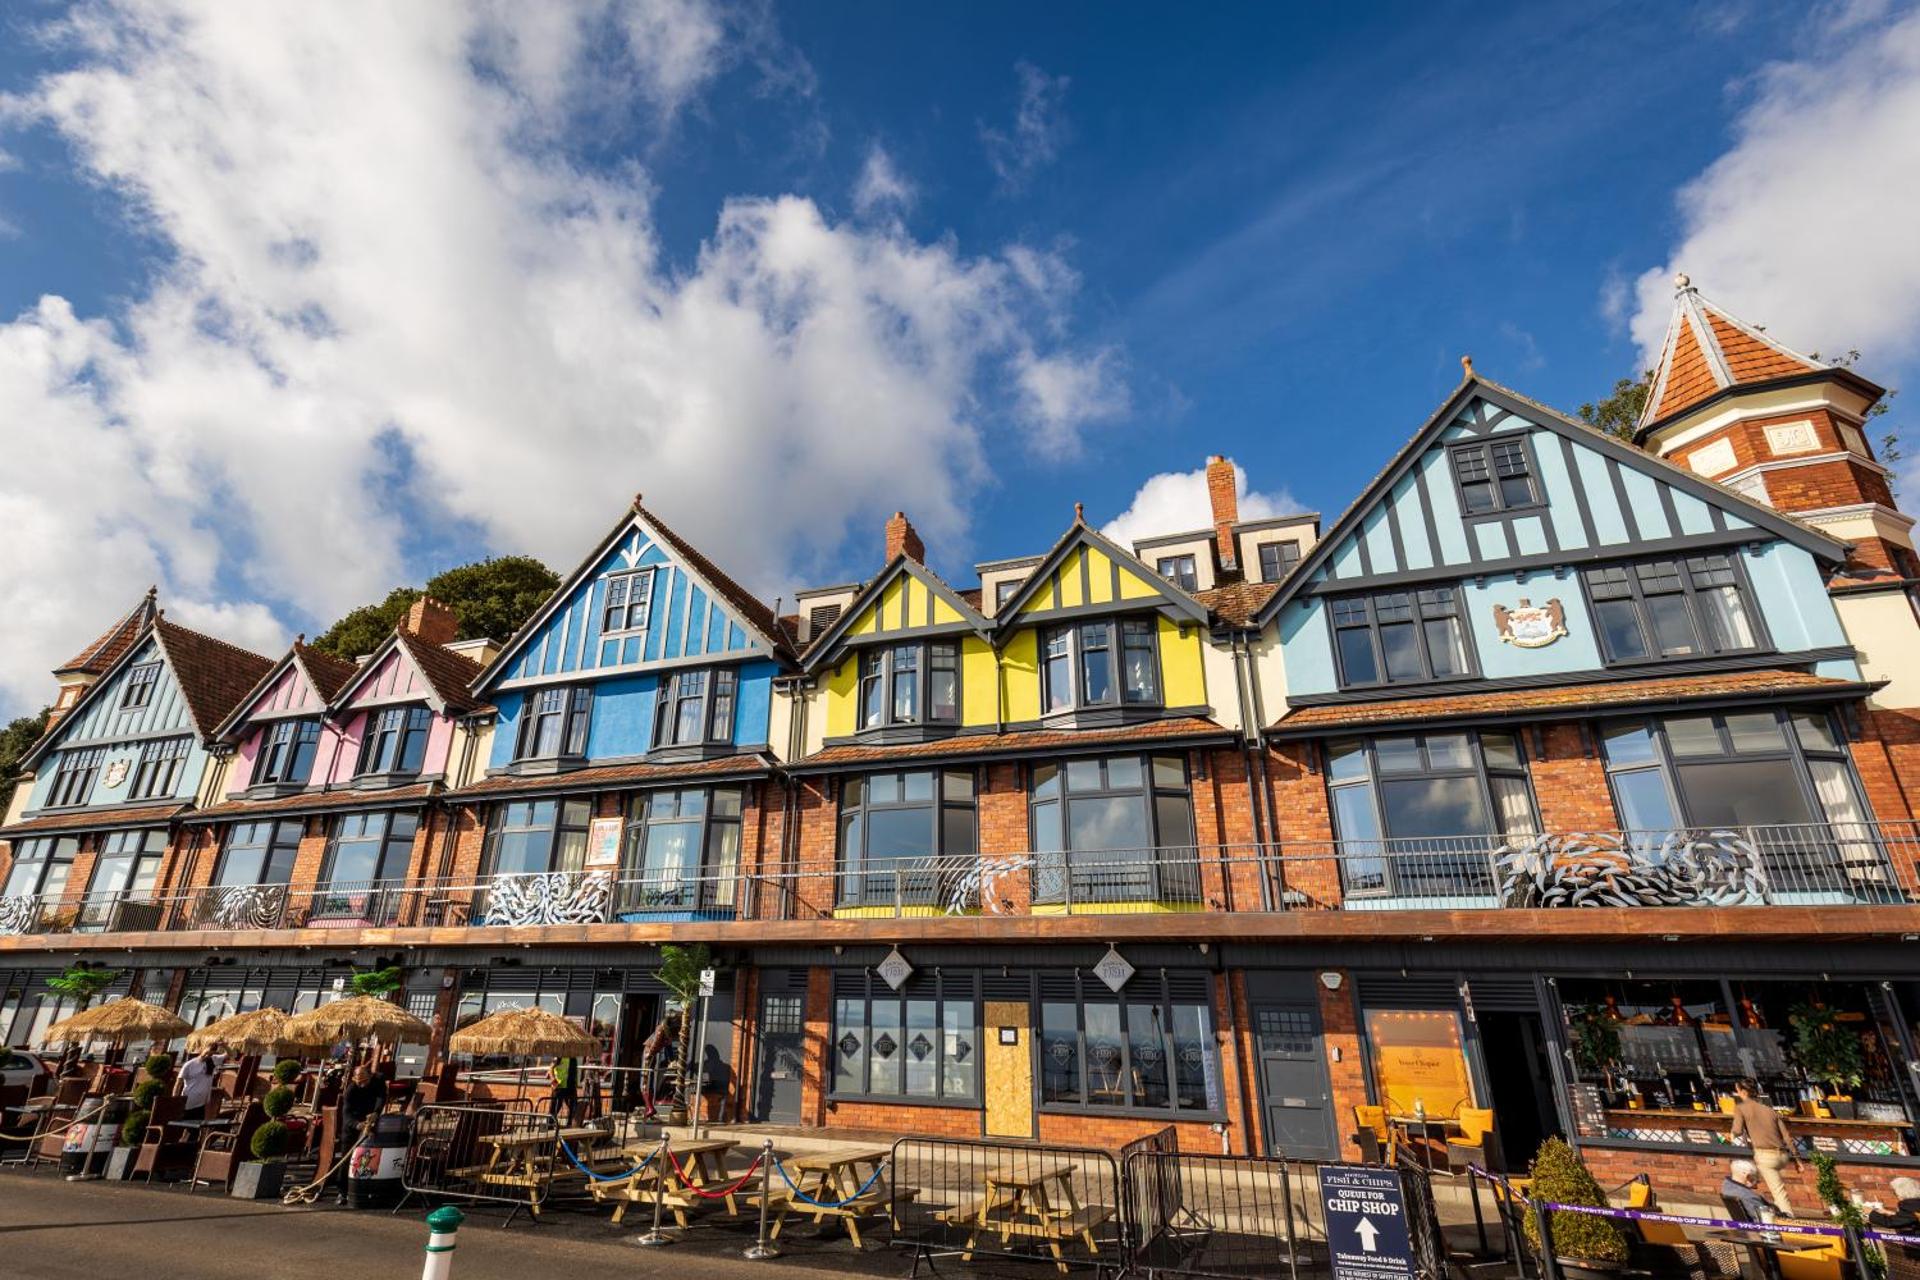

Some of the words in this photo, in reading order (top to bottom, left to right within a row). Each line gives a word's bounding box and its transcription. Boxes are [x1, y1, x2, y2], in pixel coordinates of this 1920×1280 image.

[1326, 1175, 1350, 1185] FISH
[1362, 1178, 1393, 1187] CHIPS
[1338, 1189, 1367, 1199] QUEUE
[1367, 1191, 1385, 1200] FOR
[1328, 1199, 1359, 1212] CHIP
[1362, 1201, 1399, 1215] SHOP
[1640, 1213, 1661, 1221] RUGBY
[1336, 1252, 1366, 1262] Takeaway
[1367, 1255, 1382, 1263] Food
[1388, 1257, 1407, 1265] Drink
